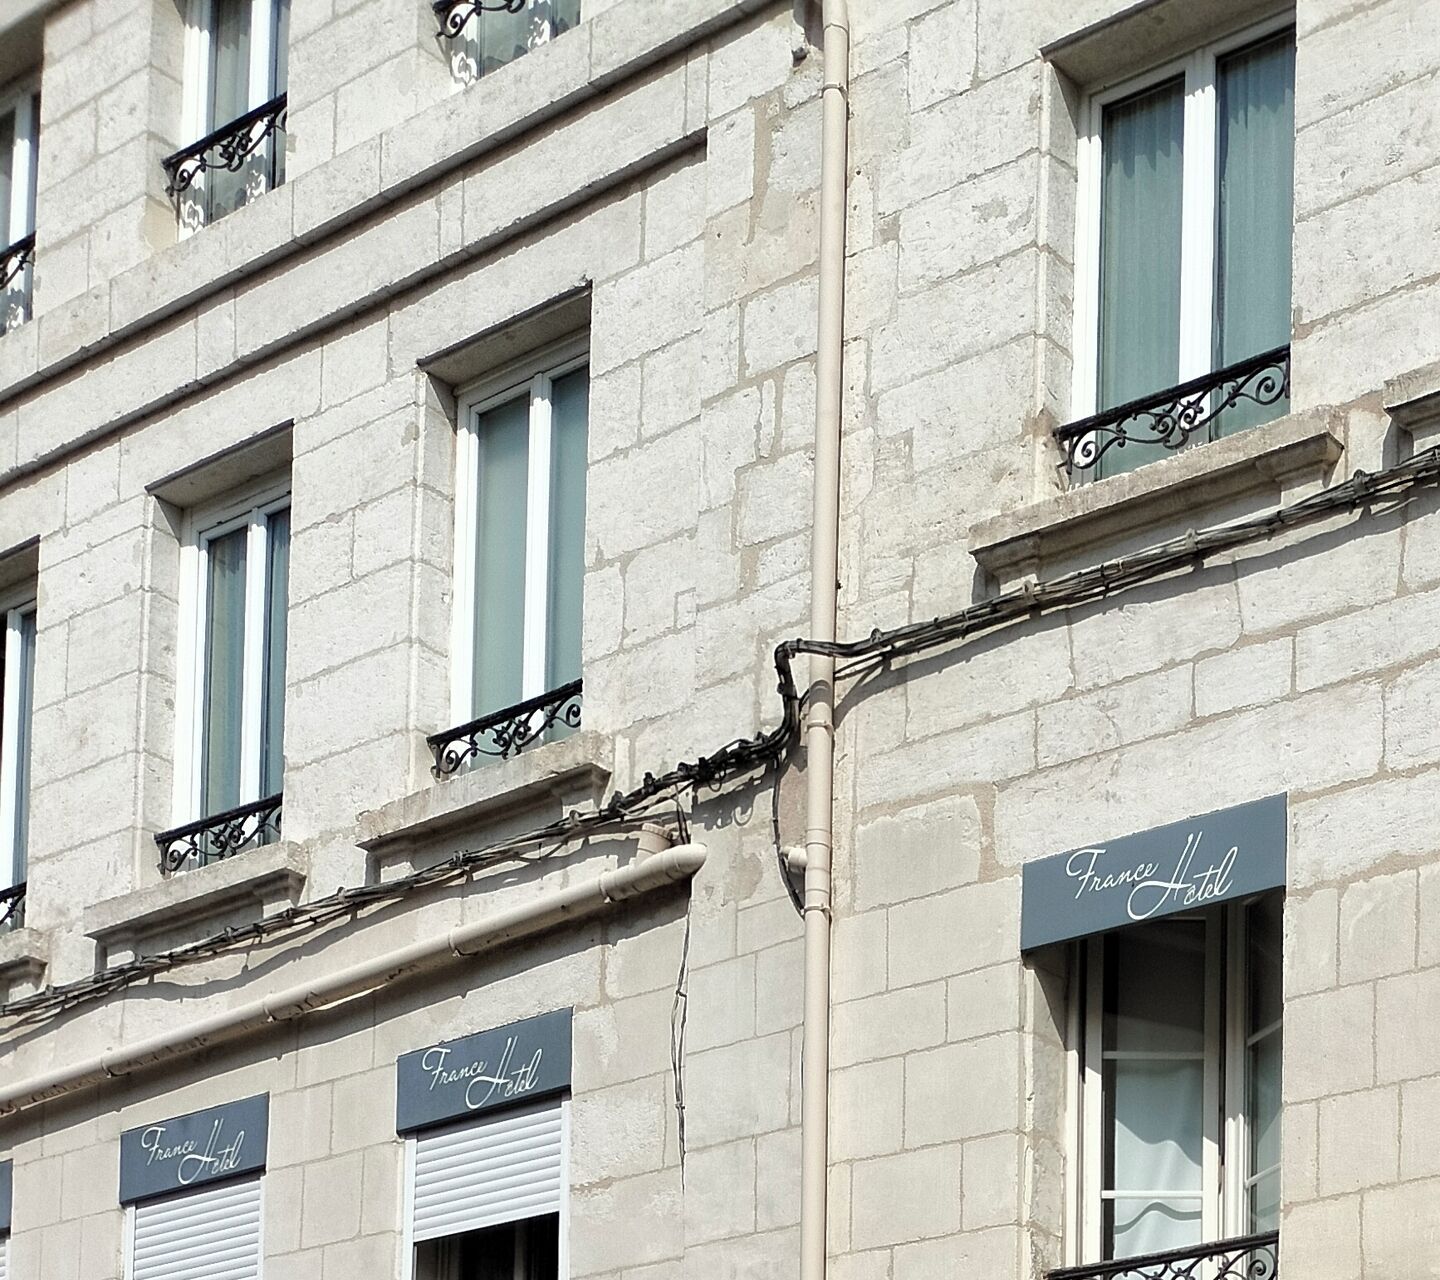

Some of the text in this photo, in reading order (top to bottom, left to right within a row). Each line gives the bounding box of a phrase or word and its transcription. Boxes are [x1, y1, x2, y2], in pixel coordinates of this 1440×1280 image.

[1065, 848, 1160, 899] France
[422, 1047, 488, 1091] France
[141, 1126, 198, 1166] France
